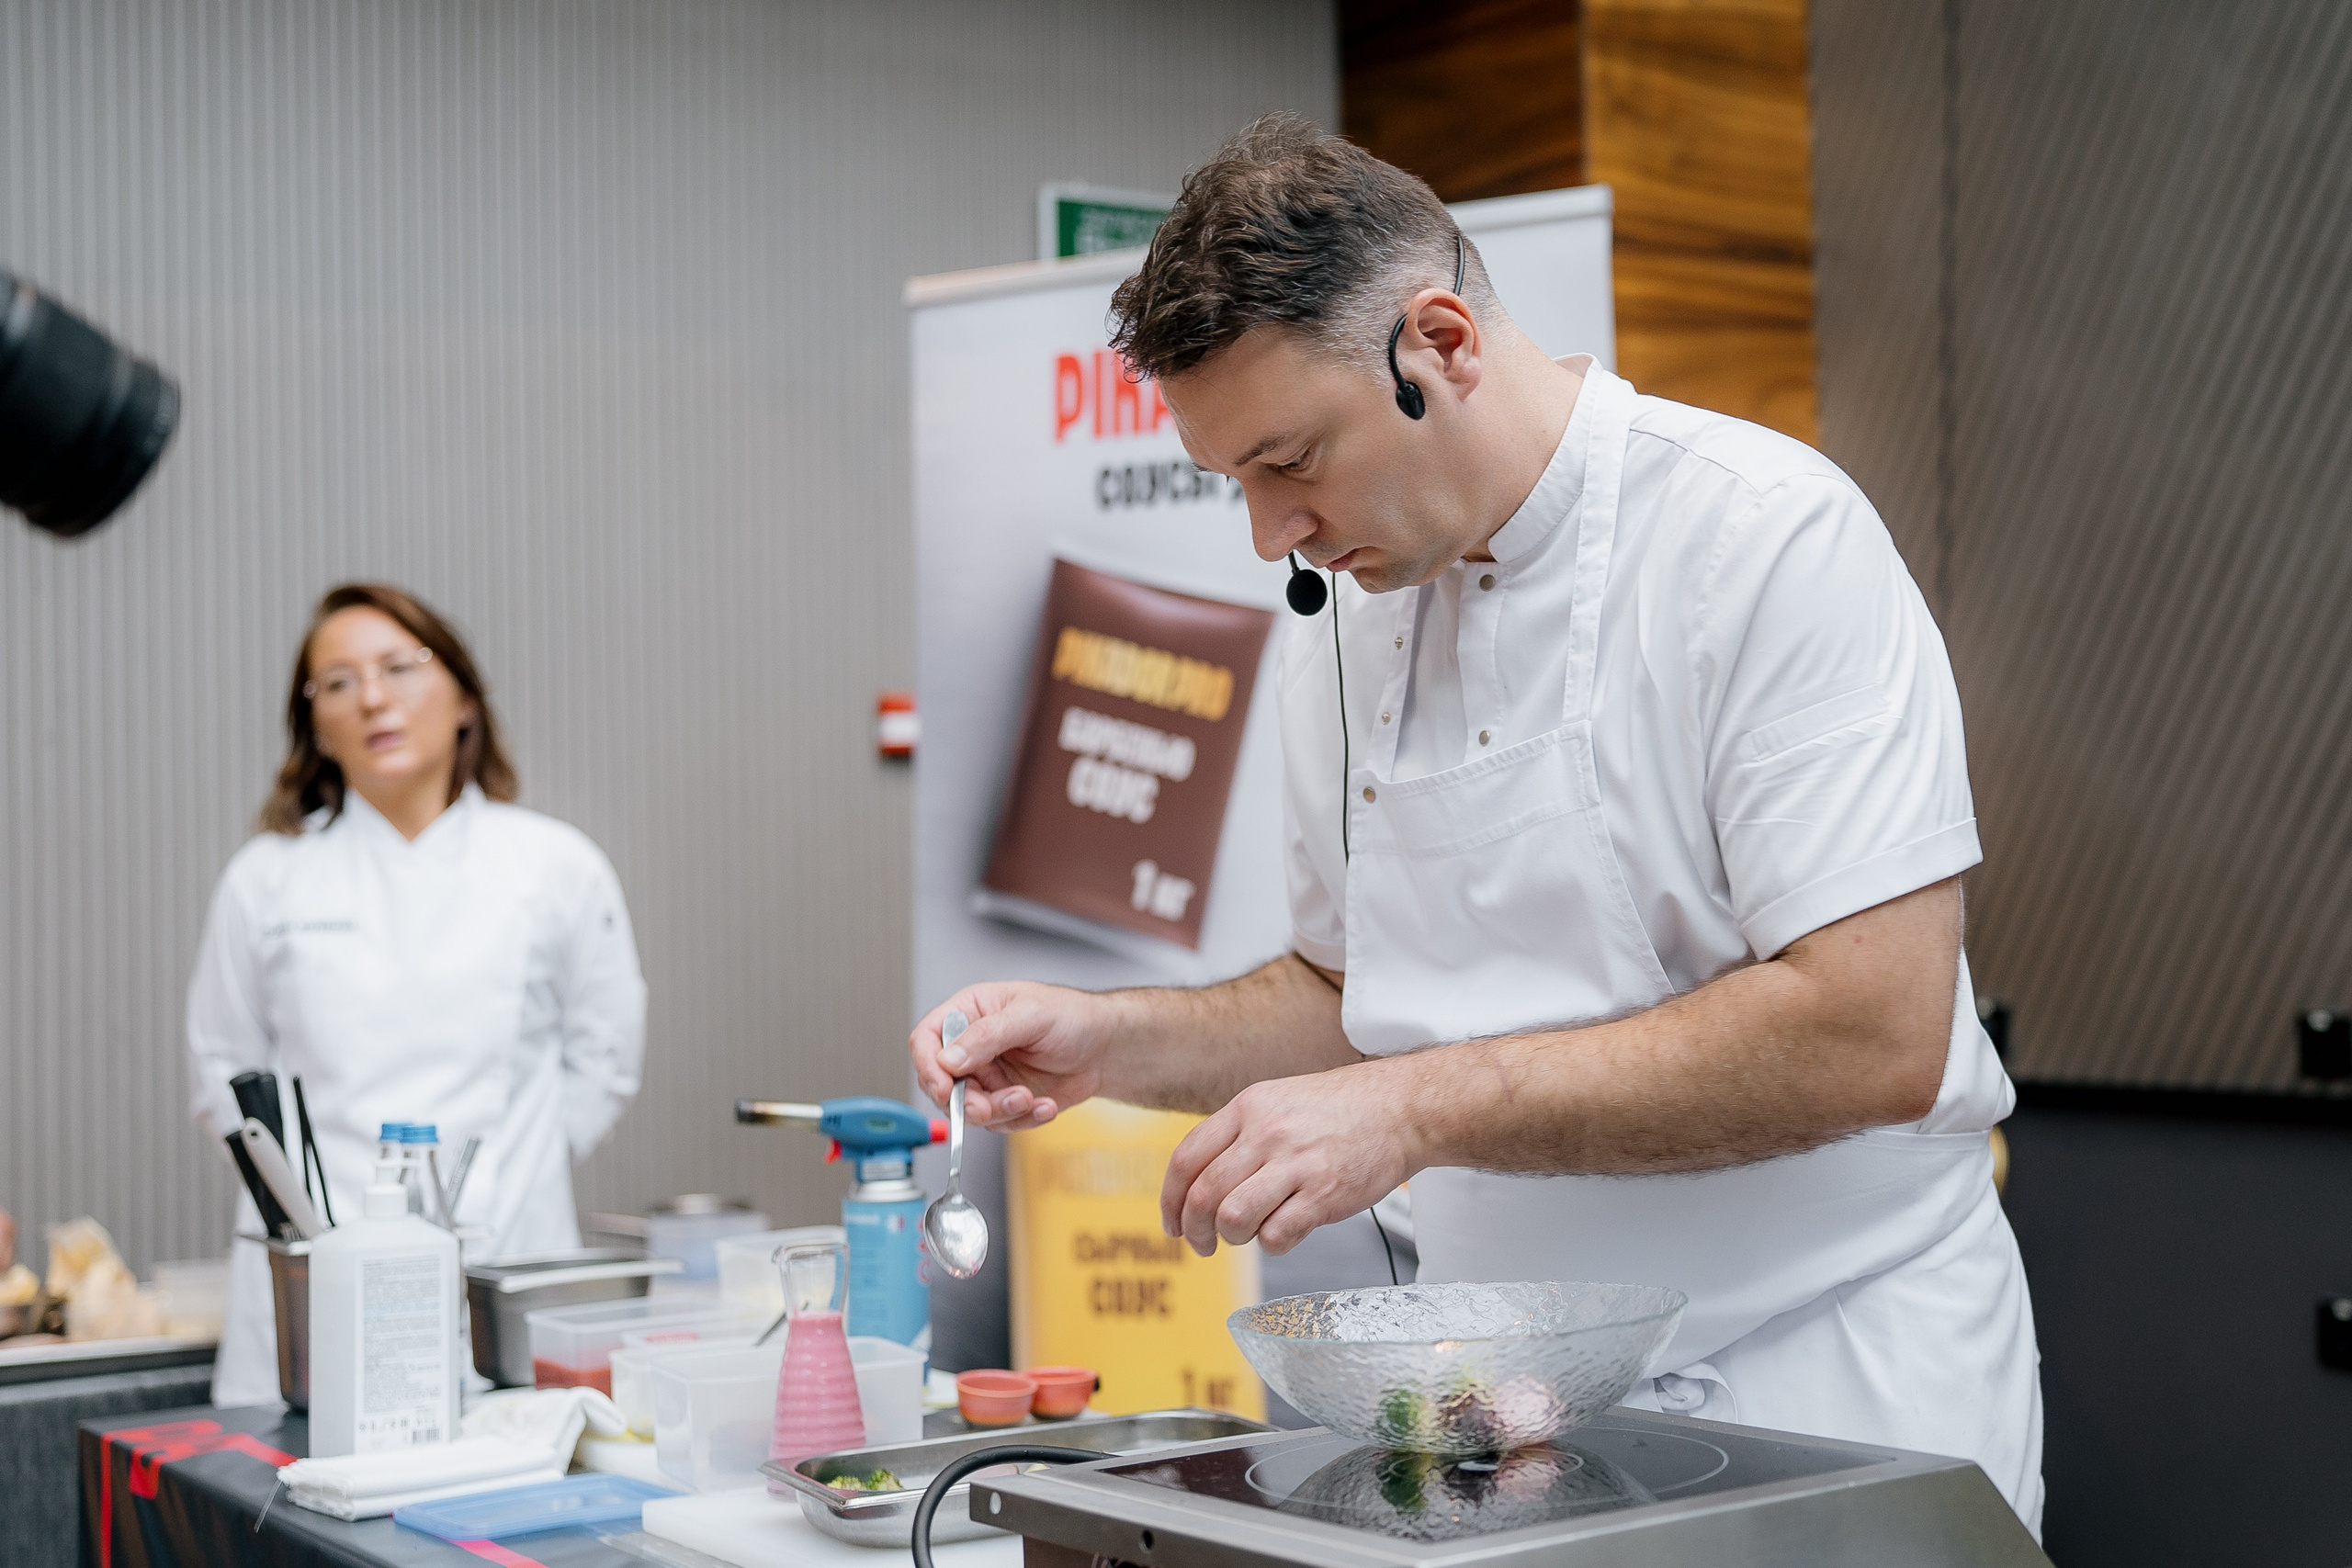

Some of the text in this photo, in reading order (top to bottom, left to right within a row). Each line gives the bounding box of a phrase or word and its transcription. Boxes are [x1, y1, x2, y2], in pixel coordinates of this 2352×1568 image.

[1067, 757, 1160, 823] СОУС
[1131, 860, 1159, 911] 1
[1089, 1276, 1171, 1319] СОУС
